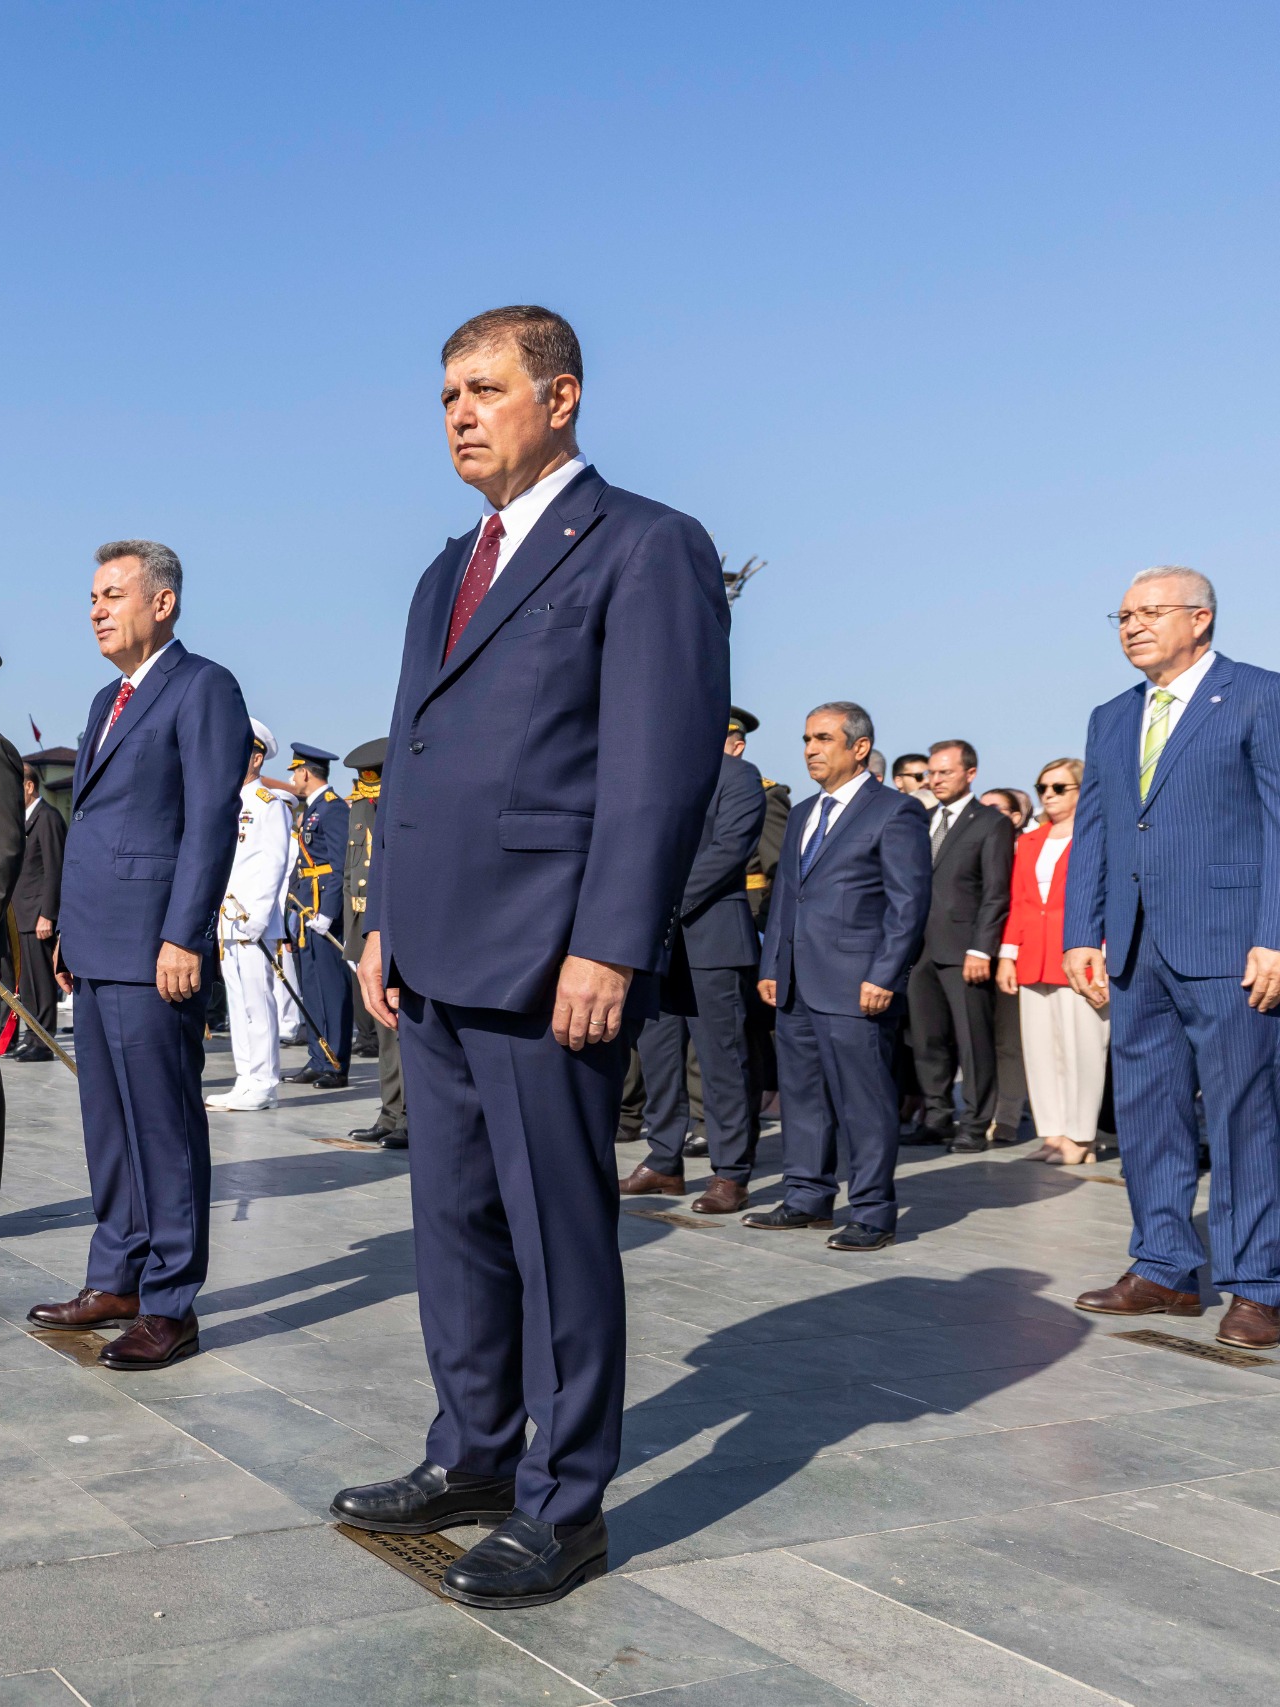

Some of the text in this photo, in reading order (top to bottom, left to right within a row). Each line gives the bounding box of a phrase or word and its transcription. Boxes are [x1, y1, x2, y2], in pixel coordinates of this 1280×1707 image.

[365, 1531, 444, 1582] ÜYÜKŞEHİR
[391, 1535, 448, 1572] ELEDİYE
[410, 1535, 457, 1564] ŞKANI
